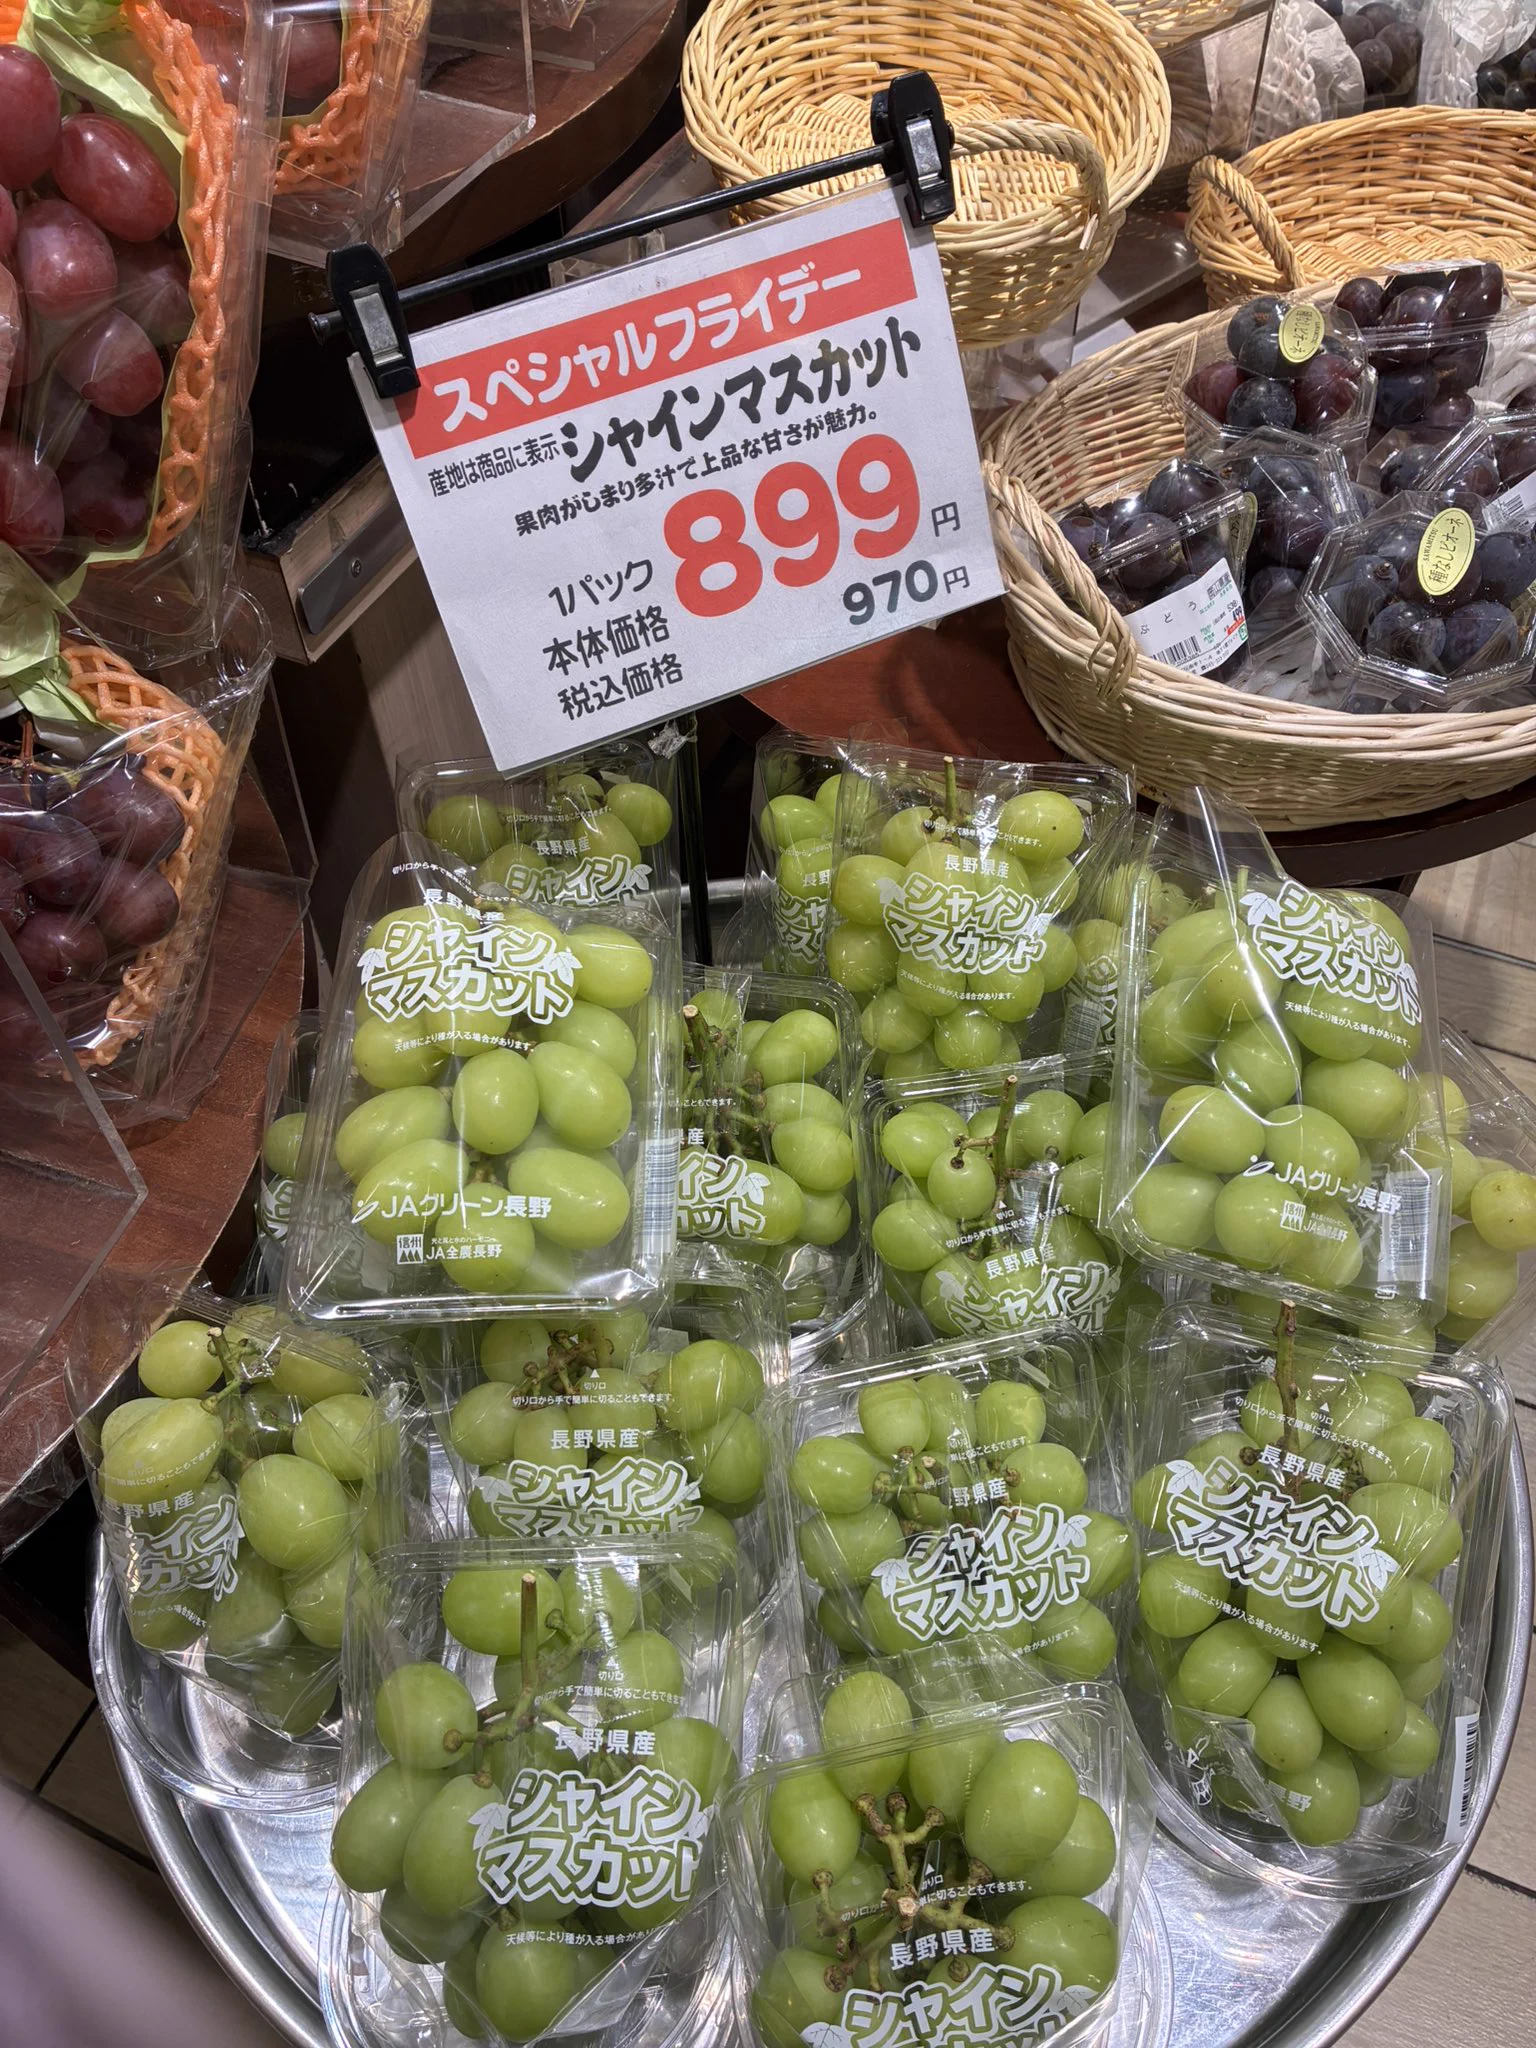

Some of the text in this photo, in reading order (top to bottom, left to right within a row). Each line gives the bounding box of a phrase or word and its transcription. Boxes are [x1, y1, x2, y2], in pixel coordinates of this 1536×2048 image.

[434, 258, 863, 433] スペシャルフライデー
[427, 316, 921, 498] 産地は商品に表示 シャインマスカット
[514, 402, 879, 537] 果肉がしまり多汁で上品な甘さが魅力。
[663, 433, 961, 618] 899 円
[548, 557, 654, 617] 1パック
[842, 560, 970, 625] 970 円
[542, 604, 670, 677] 本体価格
[558, 652, 684, 722] 税込価格
[537, 835, 591, 857] 長野県産
[945, 854, 1009, 879] 長野県産
[506, 855, 631, 903] シャイン
[905, 874, 1035, 934] シャイン
[385, 921, 557, 971] シャイン
[884, 906, 1046, 973] マスカット
[367, 957, 573, 1024] マスカット
[1255, 924, 1421, 1026] マスカット
[394, 1031, 535, 1052] 天候等により種が入る場合があります。
[381, 1193, 552, 1219] JAグリーン長野
[1275, 1162, 1402, 1216] JAグリーン長野
[399, 1236, 422, 1248] 信州
[426, 1244, 503, 1260] JA全農長野
[512, 1393, 675, 1406] 切り口から手で簡単に切ることもできます。
[583, 1381, 607, 1391] 切り口
[551, 1428, 639, 1451] 長野県産
[1310, 1410, 1334, 1426] 切り口
[508, 1457, 687, 1515] シャイン
[1258, 1444, 1346, 1490] 長野県産
[1203, 1457, 1378, 1561] シャイン
[908, 1504, 1063, 1584] シャイン
[1169, 1496, 1378, 1625] マスカット
[894, 1550, 1088, 1638] マスカット
[598, 1670, 624, 1682] 切り口
[555, 1726, 656, 1757] 長野県産
[507, 1770, 697, 1840] シャイン
[481, 1834, 700, 1904] マスカット
[889, 1927, 995, 1971] 長野県産
[843, 1964, 1061, 2048] シャイン
